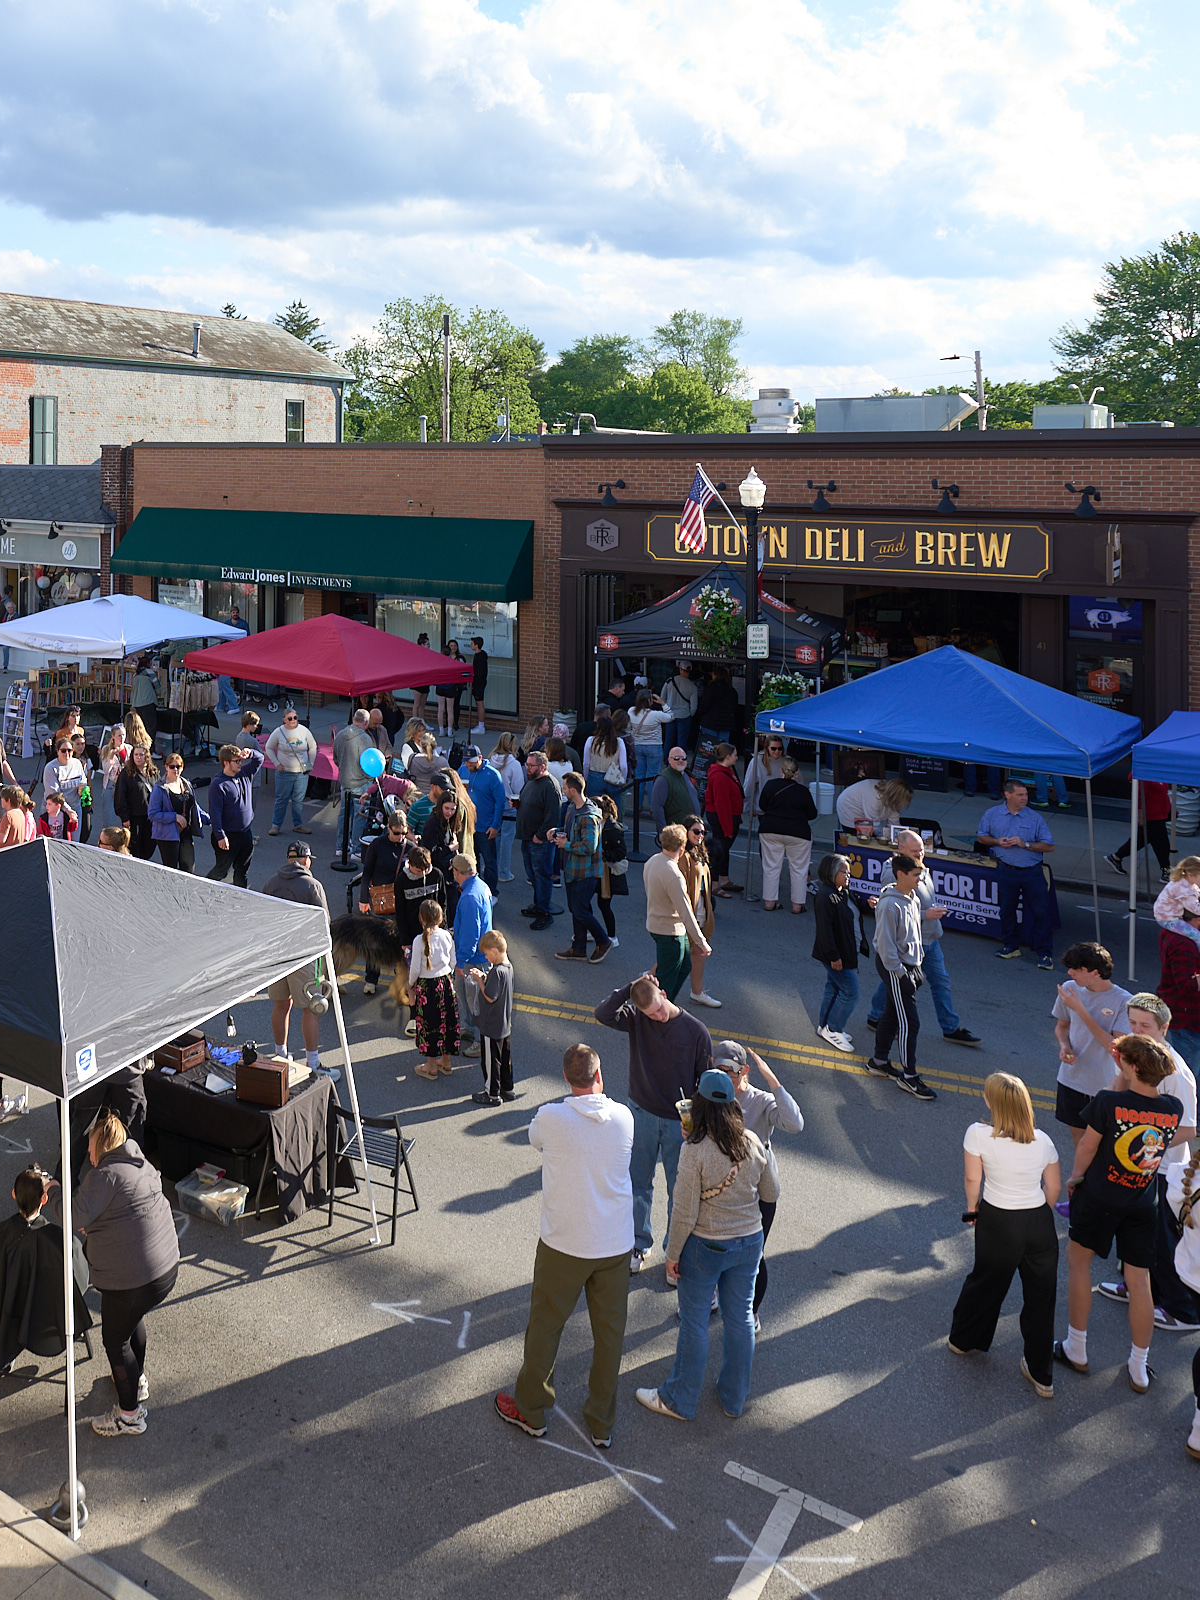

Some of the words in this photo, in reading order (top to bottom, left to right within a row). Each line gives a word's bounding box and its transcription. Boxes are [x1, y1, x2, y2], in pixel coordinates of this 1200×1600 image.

[805, 526, 864, 562] DELI
[873, 531, 909, 558] and
[915, 529, 1012, 569] BREW
[291, 575, 352, 588] INVESTMENTS
[1036, 641, 1046, 650] 41
[933, 869, 974, 901] FOR
[979, 879, 998, 905] LI
[975, 903, 1000, 916] Servi
[1115, 1106, 1179, 1128] HOOTERS
